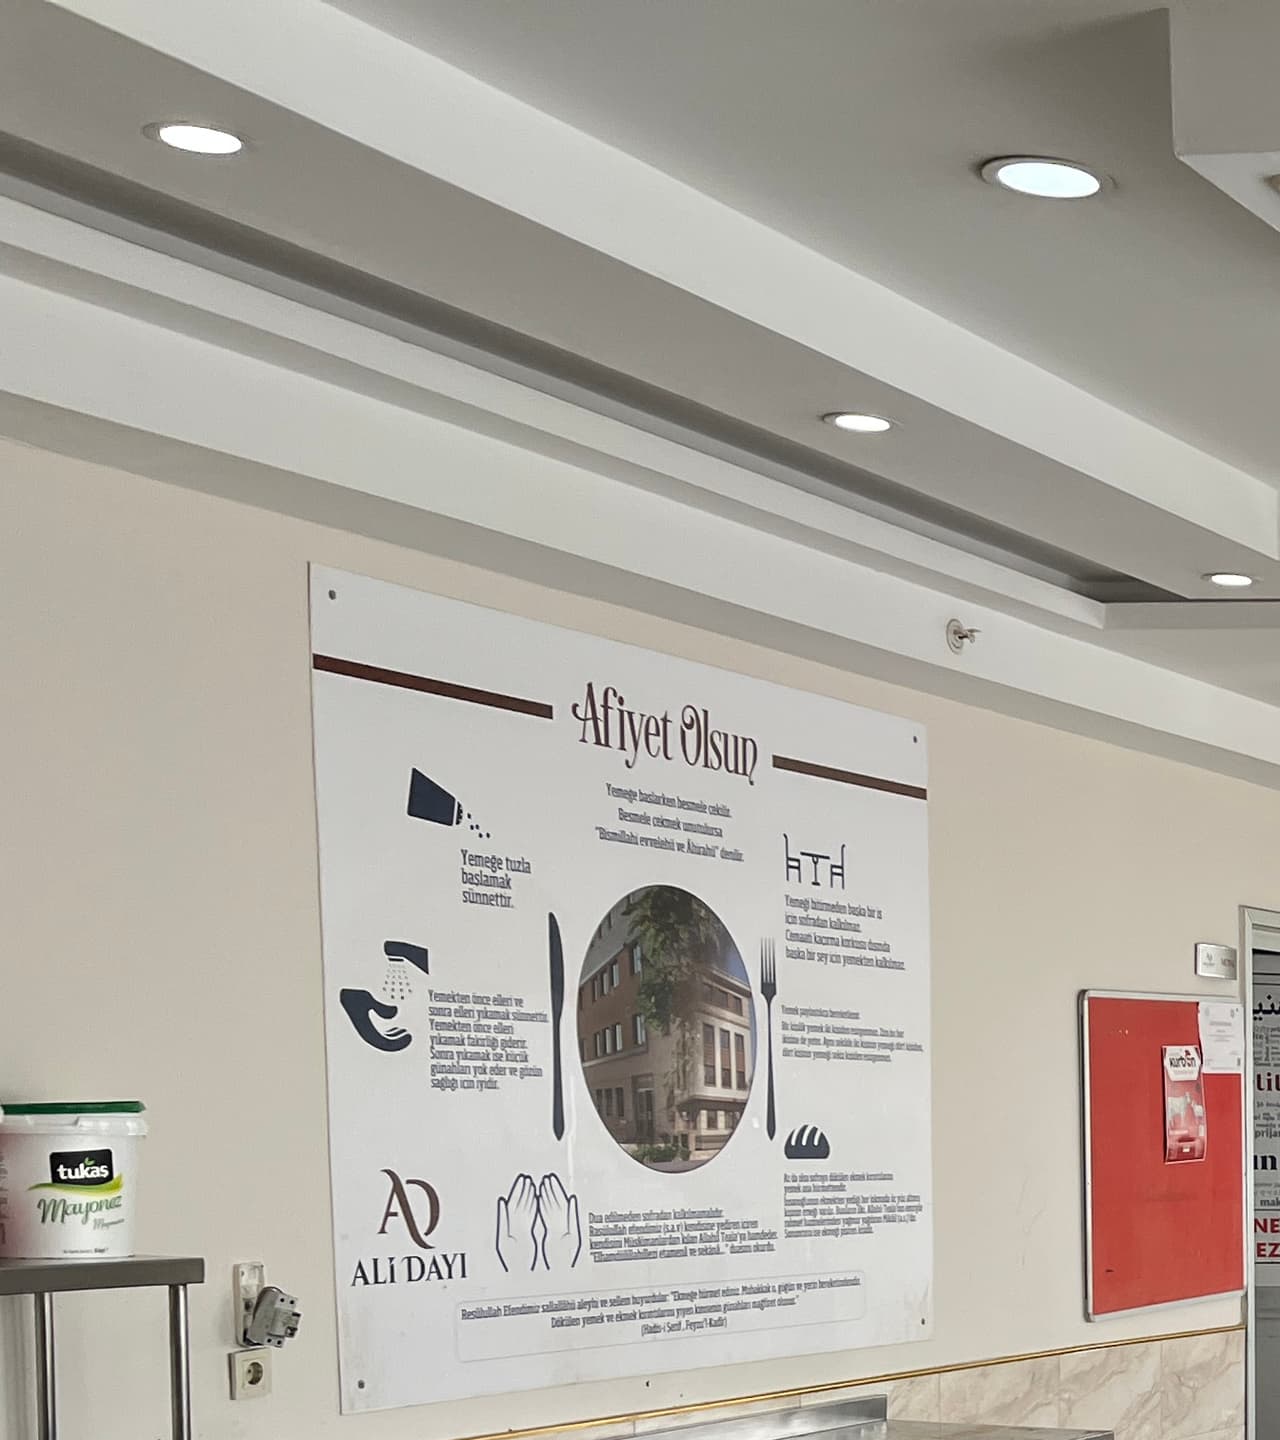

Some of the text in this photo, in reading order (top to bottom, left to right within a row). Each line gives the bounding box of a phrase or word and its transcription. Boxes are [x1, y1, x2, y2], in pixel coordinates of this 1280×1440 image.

[571, 682, 758, 786] Afiyet Olsun
[460, 848, 532, 874] Yemeğe tuzla
[461, 867, 512, 890] başlamak
[462, 887, 515, 909] sünnettir.
[401, 1252, 468, 1283] DAYI
